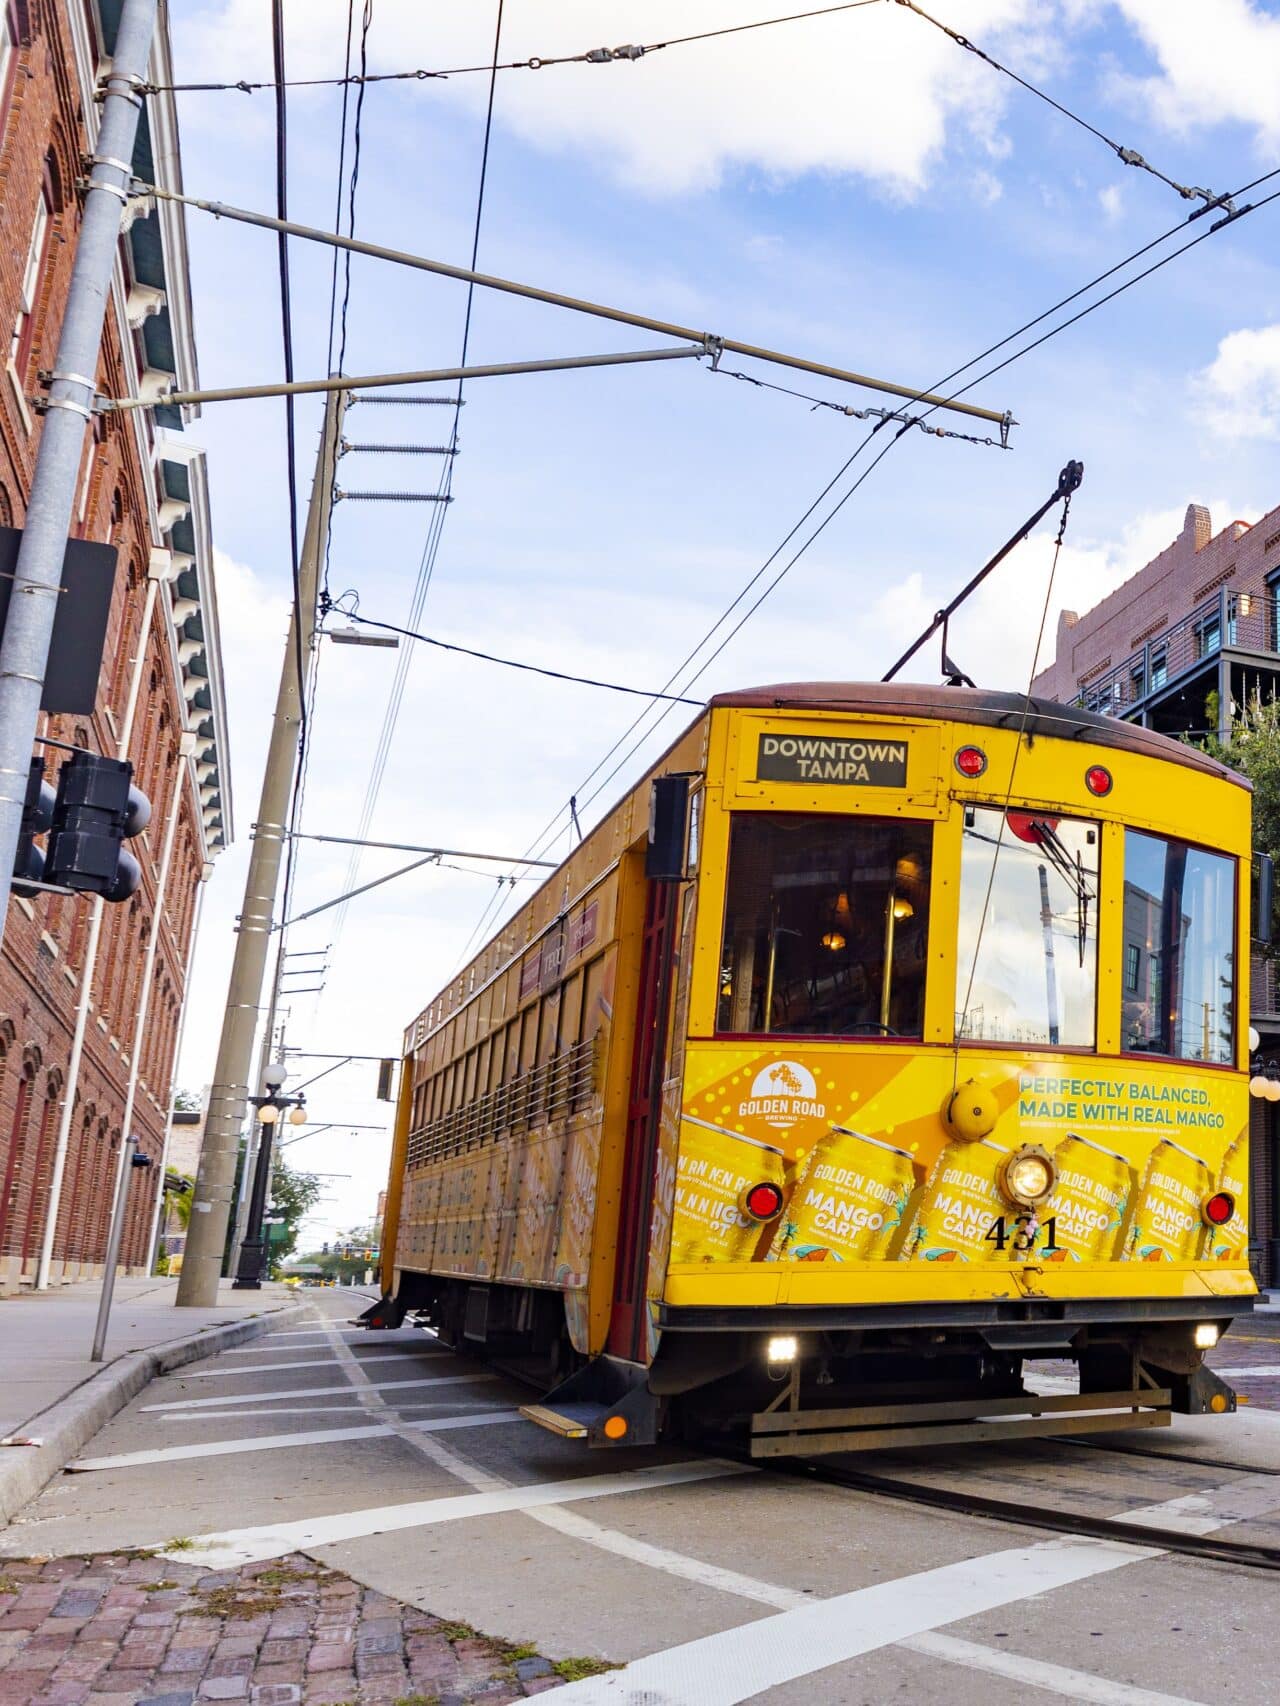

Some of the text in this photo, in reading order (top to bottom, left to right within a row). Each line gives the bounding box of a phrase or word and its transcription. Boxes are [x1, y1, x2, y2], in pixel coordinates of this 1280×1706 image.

[762, 737, 906, 763] DOWNTOWN
[796, 758, 870, 782] TAMPA
[1019, 1075, 1211, 1107] PERFECTLY BALANCED,
[739, 1099, 826, 1118] GOLDEN ROAD
[1019, 1100, 1076, 1119] MADE
[1082, 1103, 1129, 1122] WITH
[1134, 1107, 1173, 1124] REAL
[1176, 1110, 1225, 1129] MANGO
[814, 1164, 896, 1206] GOLDEN ROAD
[942, 1168, 990, 1194] GOLDEN
[1150, 1171, 1182, 1195] GOLDEN
[804, 1189, 883, 1231] MANGO
[934, 1192, 1004, 1232] MANG
[1047, 1195, 1109, 1231] MANGO
[1145, 1195, 1194, 1231] MANGO
[814, 1213, 861, 1240] CART
[943, 1216, 987, 1242] CART
[985, 1216, 1062, 1250] 431
[1055, 1215, 1094, 1239] CART
[1152, 1216, 1182, 1240] CART
